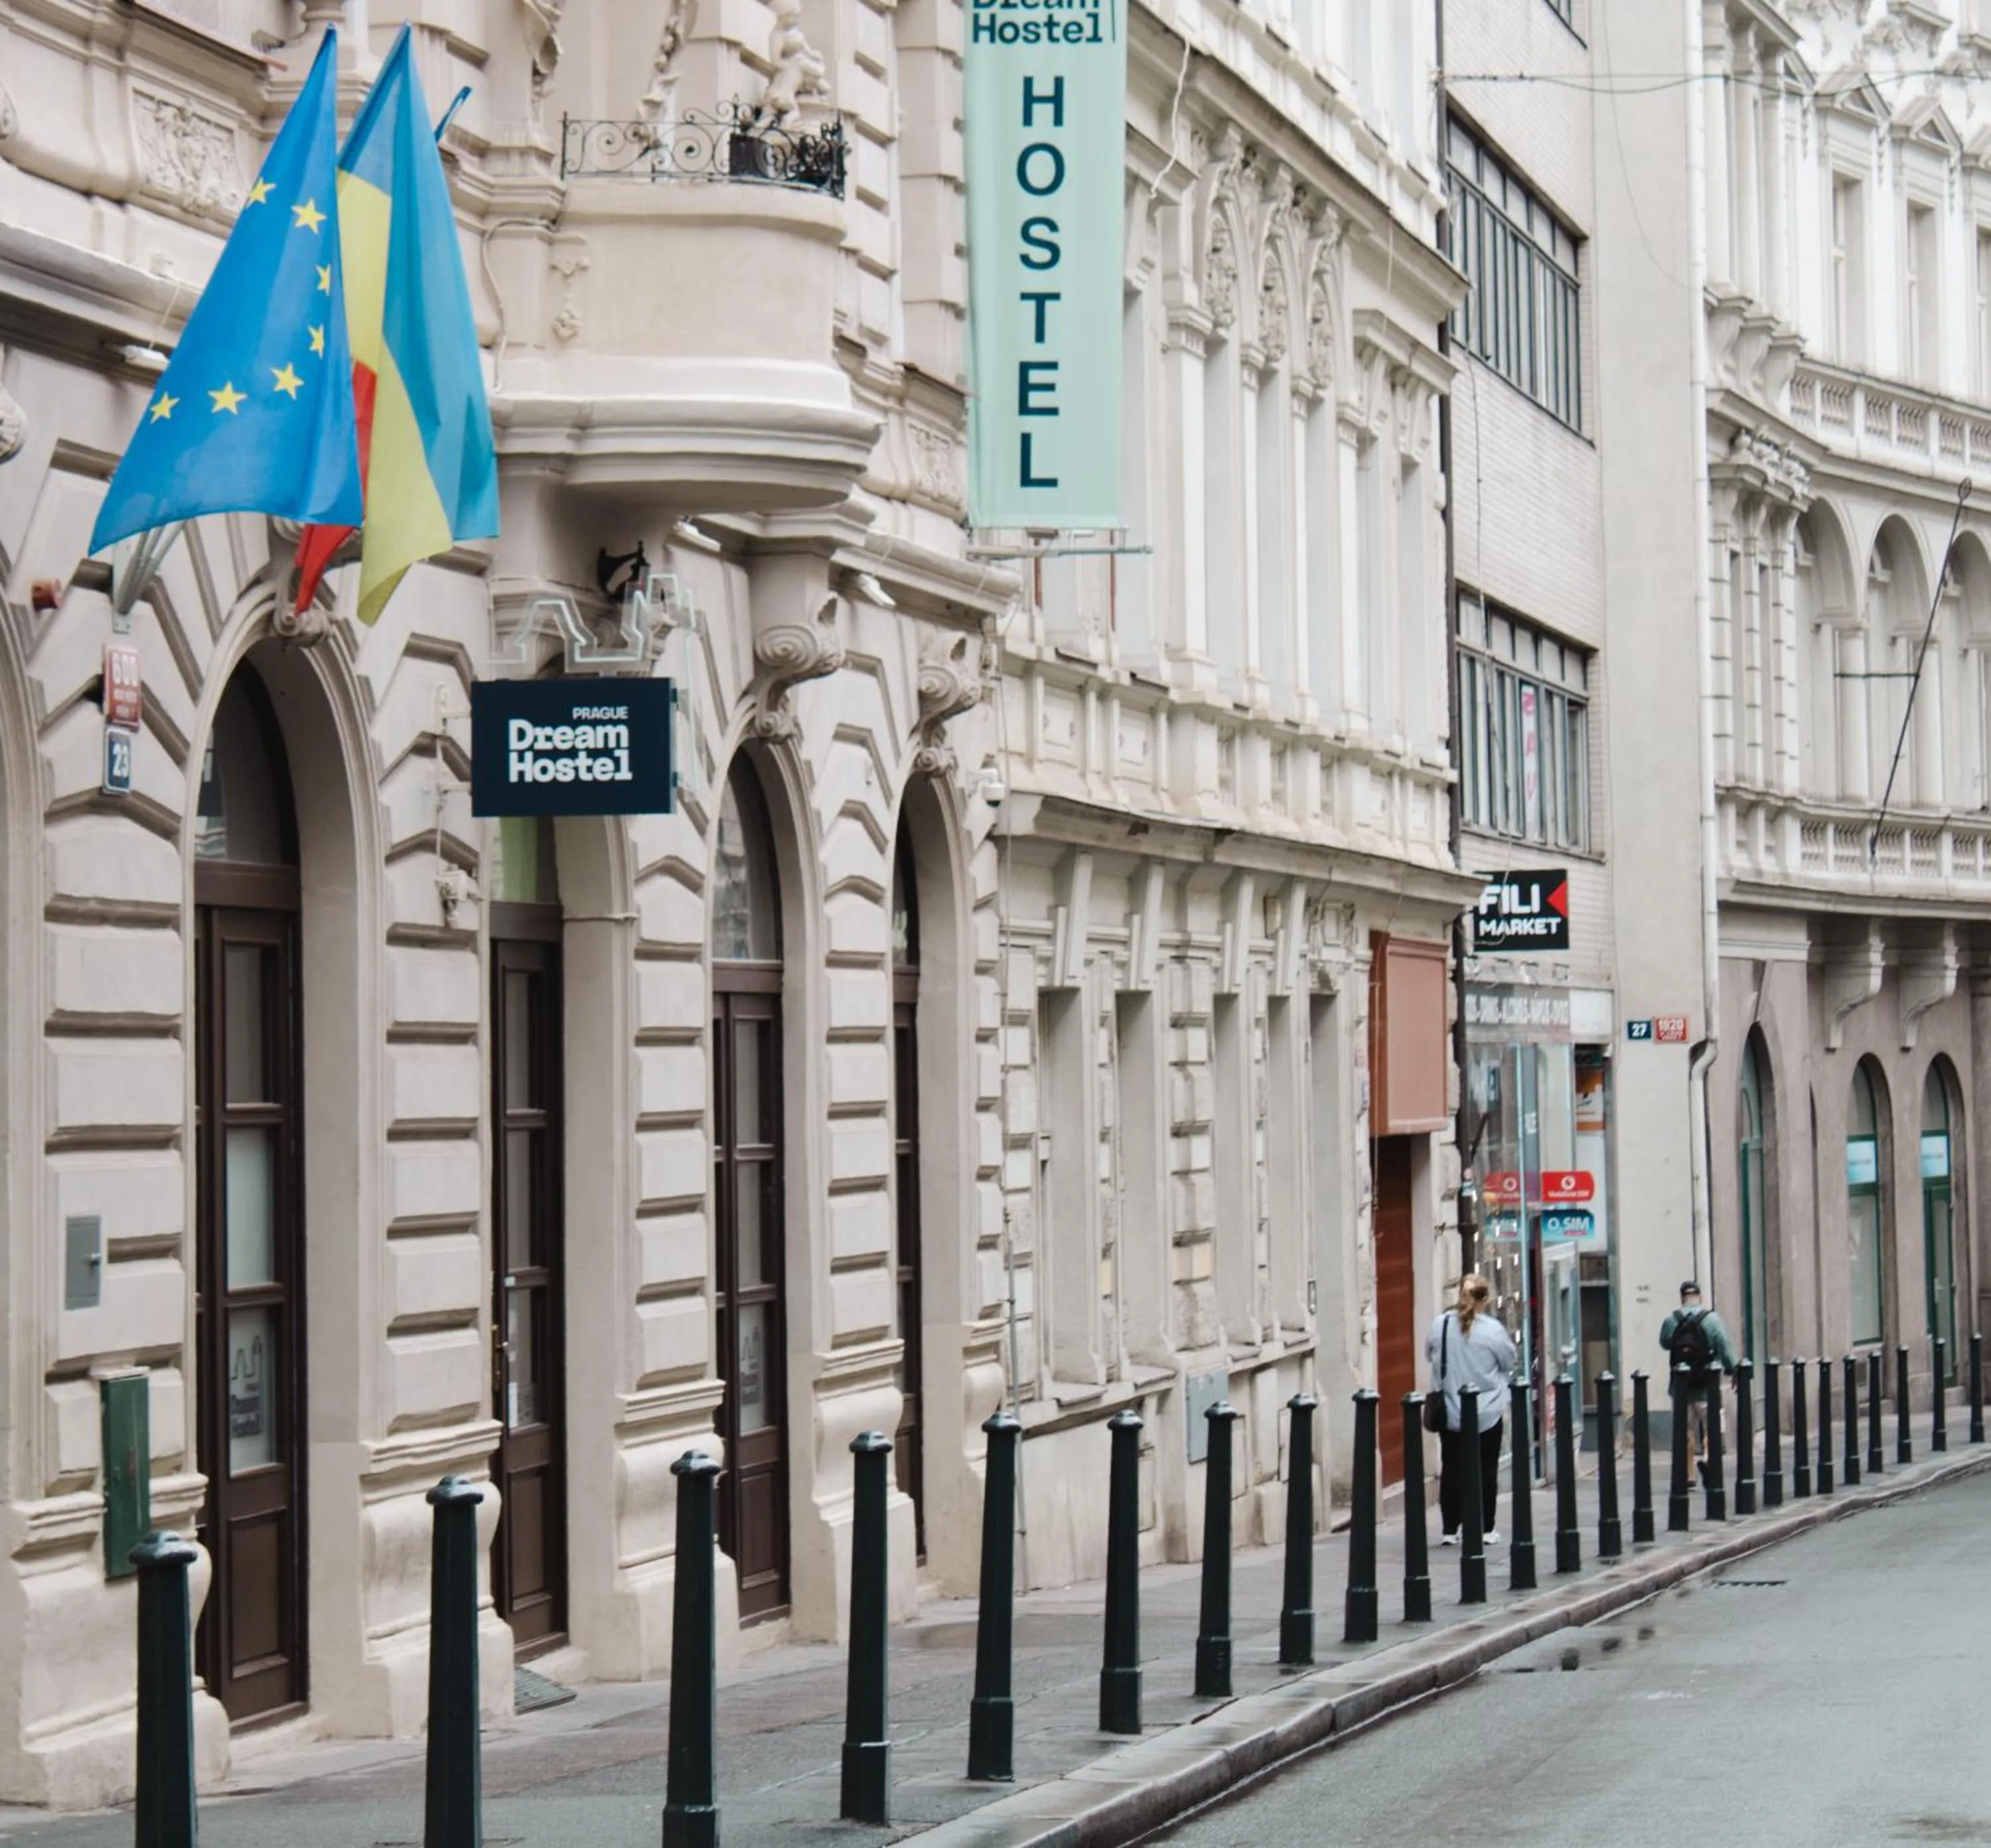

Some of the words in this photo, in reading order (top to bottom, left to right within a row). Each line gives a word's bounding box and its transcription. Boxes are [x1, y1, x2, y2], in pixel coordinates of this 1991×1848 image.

[972, 12, 1103, 44] Hostel
[1016, 76, 1066, 487] HOSTEL
[572, 706, 629, 720] PRAGUE
[508, 718, 629, 751] Dream
[508, 749, 633, 783] Hostel
[1479, 883, 1540, 915] FILI
[1479, 917, 1562, 937] MARKET
[1631, 1023, 1647, 1037] 27
